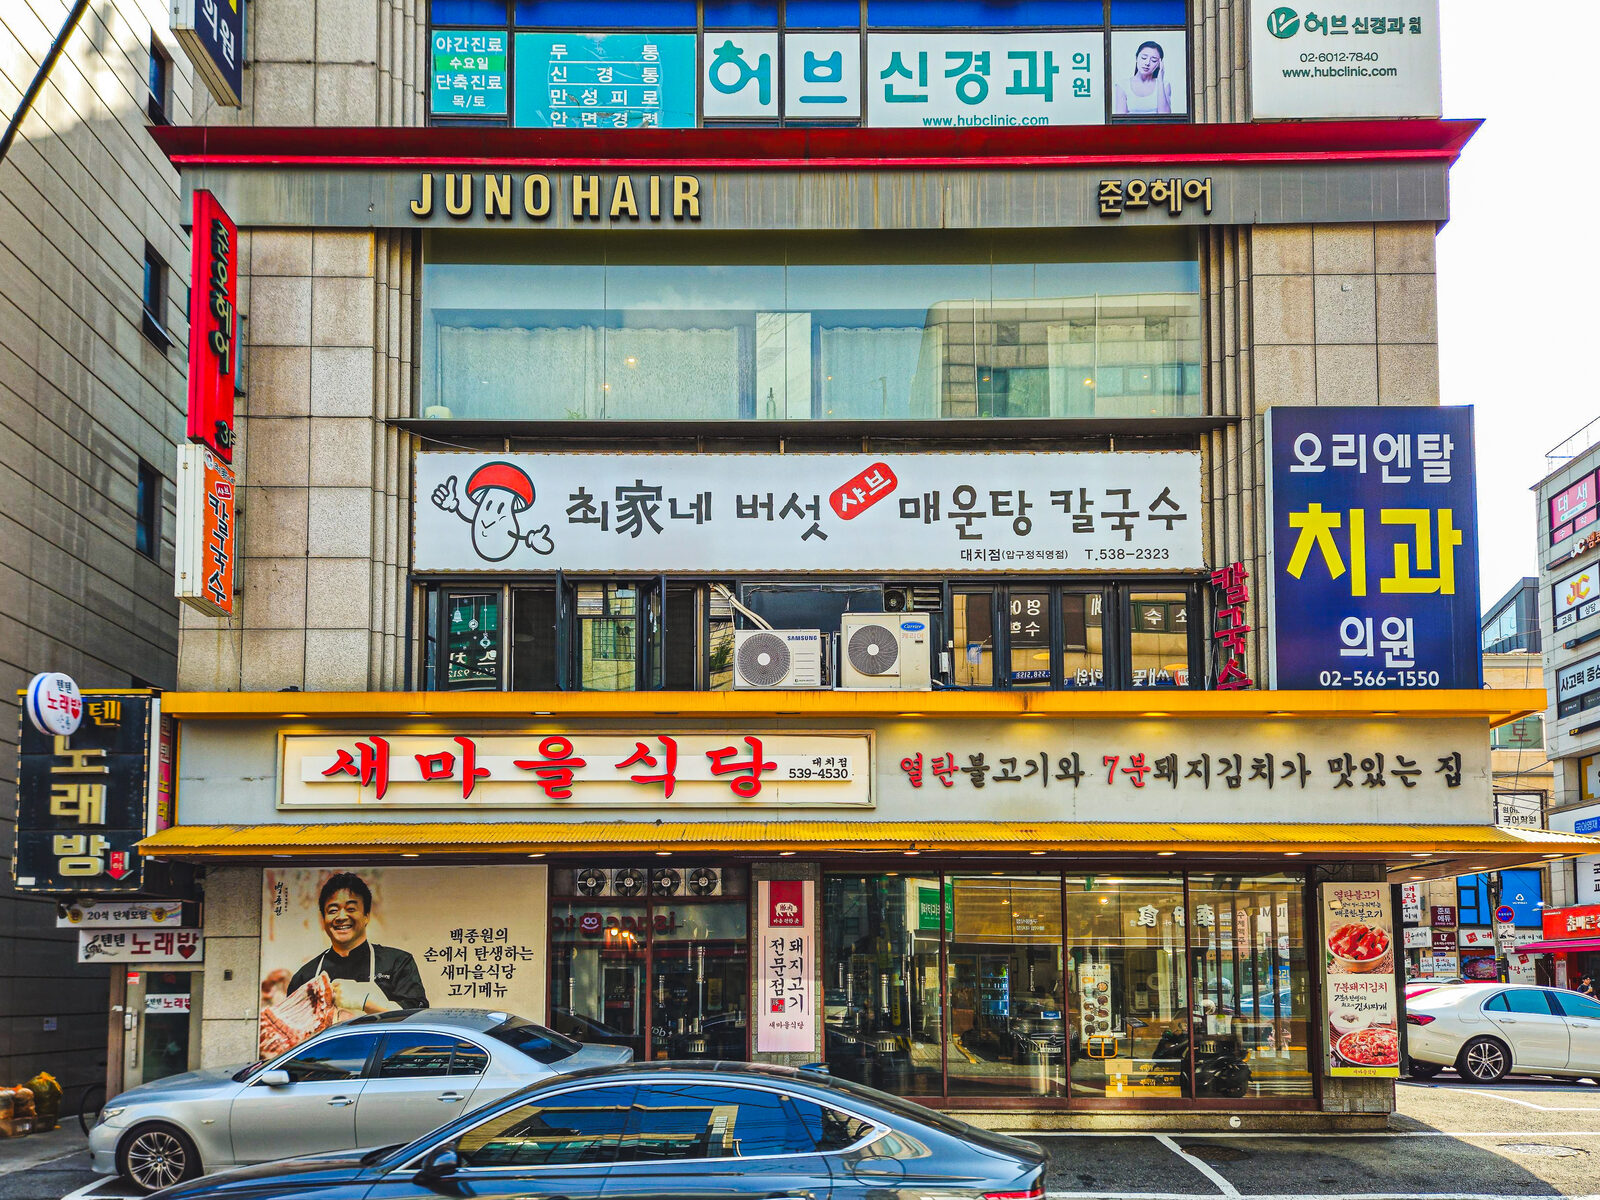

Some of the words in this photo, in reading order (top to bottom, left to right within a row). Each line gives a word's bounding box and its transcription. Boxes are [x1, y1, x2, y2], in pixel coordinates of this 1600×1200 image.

[1304, 12, 1349, 36] 허브
[1352, 16, 1405, 35] 신경과
[435, 36, 503, 53] 야간진료
[449, 58, 489, 70] 수요일
[709, 40, 848, 105] 허브
[879, 51, 1060, 105] 신경과
[1071, 52, 1092, 98] 의원
[1282, 66, 1397, 78] www.hubclinic.com
[435, 75, 503, 91] 단축진료
[452, 95, 486, 108] 목/토
[550, 88, 660, 106] 만성피로
[922, 114, 1049, 127] www.hubclinic.com
[410, 173, 552, 220] JUNO
[572, 174, 701, 221] HAIR
[1099, 178, 1213, 217] 준오헤어
[210, 219, 233, 375] 준오헤어
[215, 420, 236, 449] 3F
[1290, 432, 1455, 484] 오리엔탈
[840, 470, 892, 513] 샤브
[566, 479, 713, 539] 최家네
[736, 492, 828, 541] 버섯
[899, 484, 1033, 541] 매운탕
[1050, 486, 1188, 542] 칼국수
[208, 492, 230, 603] 칼국수
[1286, 503, 1463, 597] 치과
[1211, 562, 1254, 690] 칼국수
[1339, 616, 1416, 669] 의원
[1319, 670, 1440, 688] 02-566-1550
[1561, 671, 1585, 692] 사고력
[321, 736, 777, 800] 새마을식당
[812, 757, 848, 768] 대치점
[900, 752, 1085, 789] 열탄불고기와
[1103, 752, 1312, 790] 7분돼지김치가
[1327, 752, 1423, 789] 맛있는
[1435, 751, 1462, 788] 집
[788, 768, 849, 780] 539-4530
[50, 735, 110, 877] 노래방
[1503, 815, 1537, 826] 국어학원
[1334, 890, 1380, 901] 열탄불고기
[101, 933, 126, 947] 텐텐
[450, 927, 509, 944] 백종원의
[424, 946, 468, 962] 손에서
[475, 945, 534, 963] 탄생하는
[441, 964, 517, 980] 새마을식당
[770, 937, 786, 996] 전문점
[788, 937, 804, 1013] 돼지고기
[448, 982, 508, 998] 고기메뉴
[1334, 982, 1388, 993] 7분돼지김치
[1354, 1002, 1388, 1012] 김치찌개
[769, 1021, 804, 1030] 새마을식당
